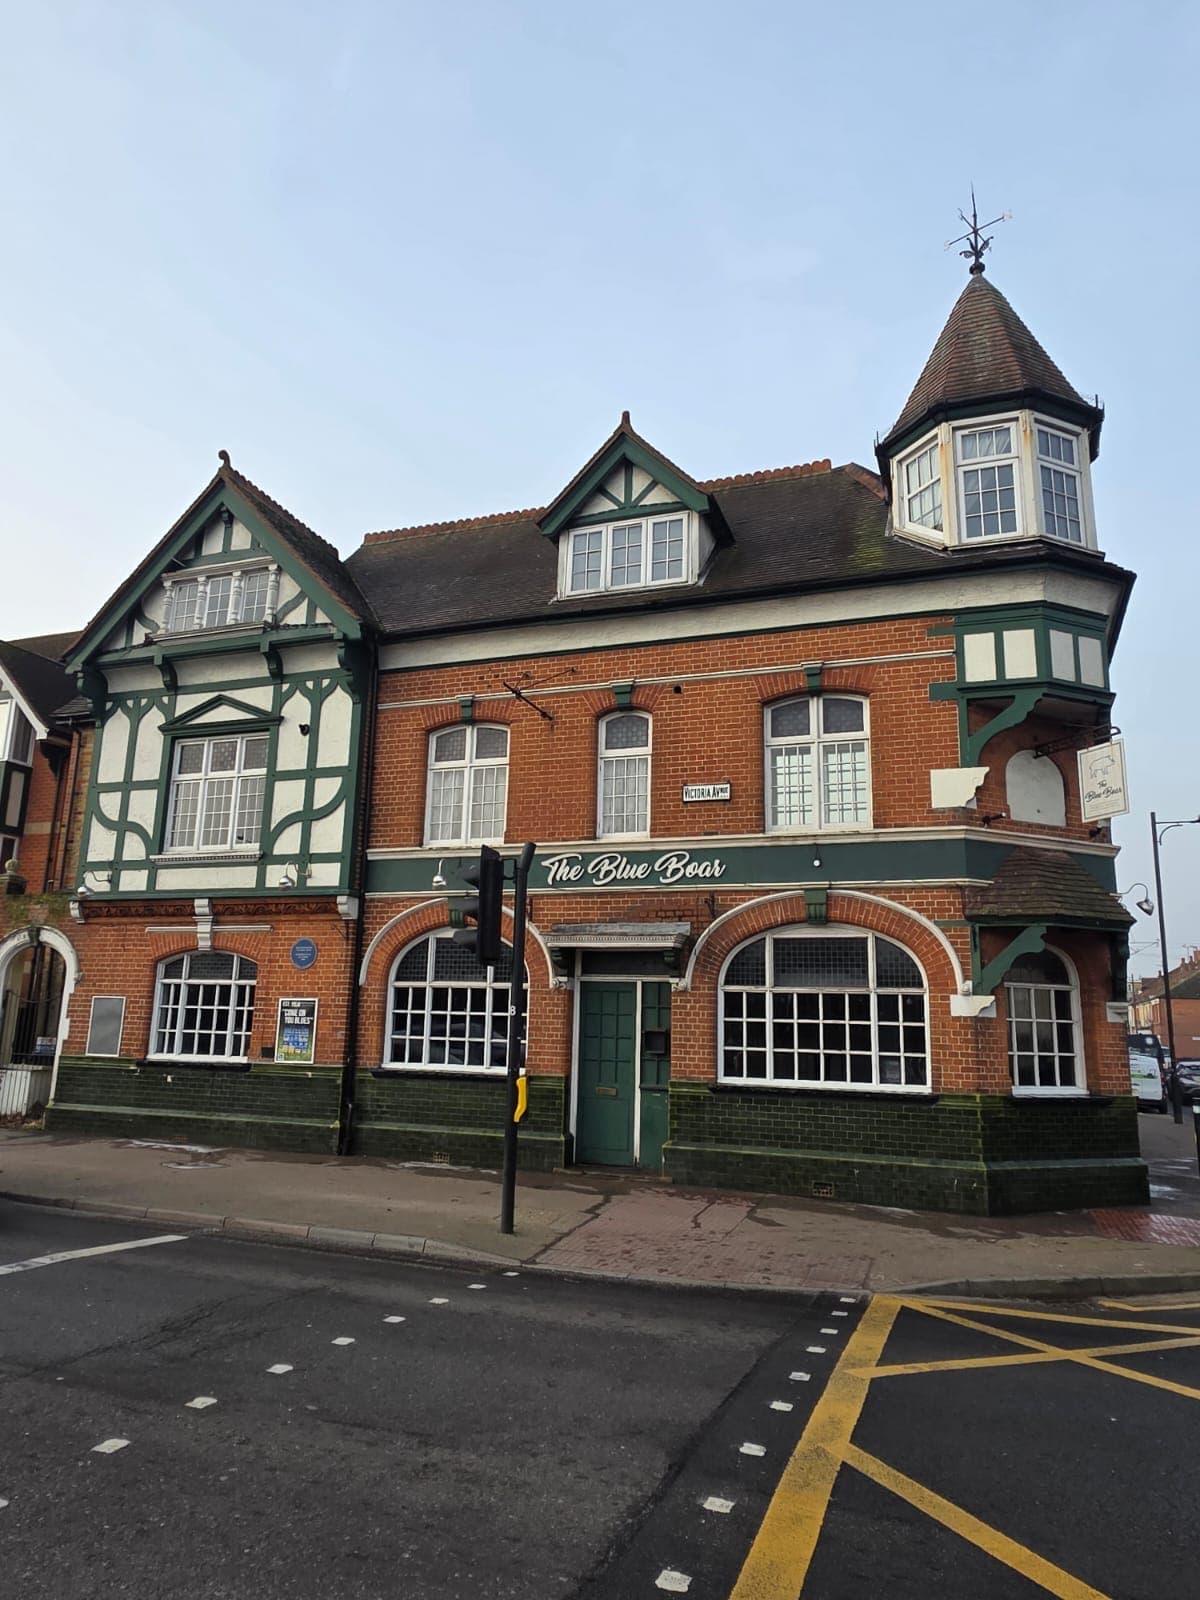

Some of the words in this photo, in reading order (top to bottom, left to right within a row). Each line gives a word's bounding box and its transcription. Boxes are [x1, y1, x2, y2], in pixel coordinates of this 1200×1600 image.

[685, 787, 711, 799] VICTORIA
[1085, 790, 1102, 803] Blue
[1102, 786, 1122, 798] Boar
[541, 853, 584, 885] The
[588, 852, 652, 886] Blue
[654, 850, 726, 884] Boar
